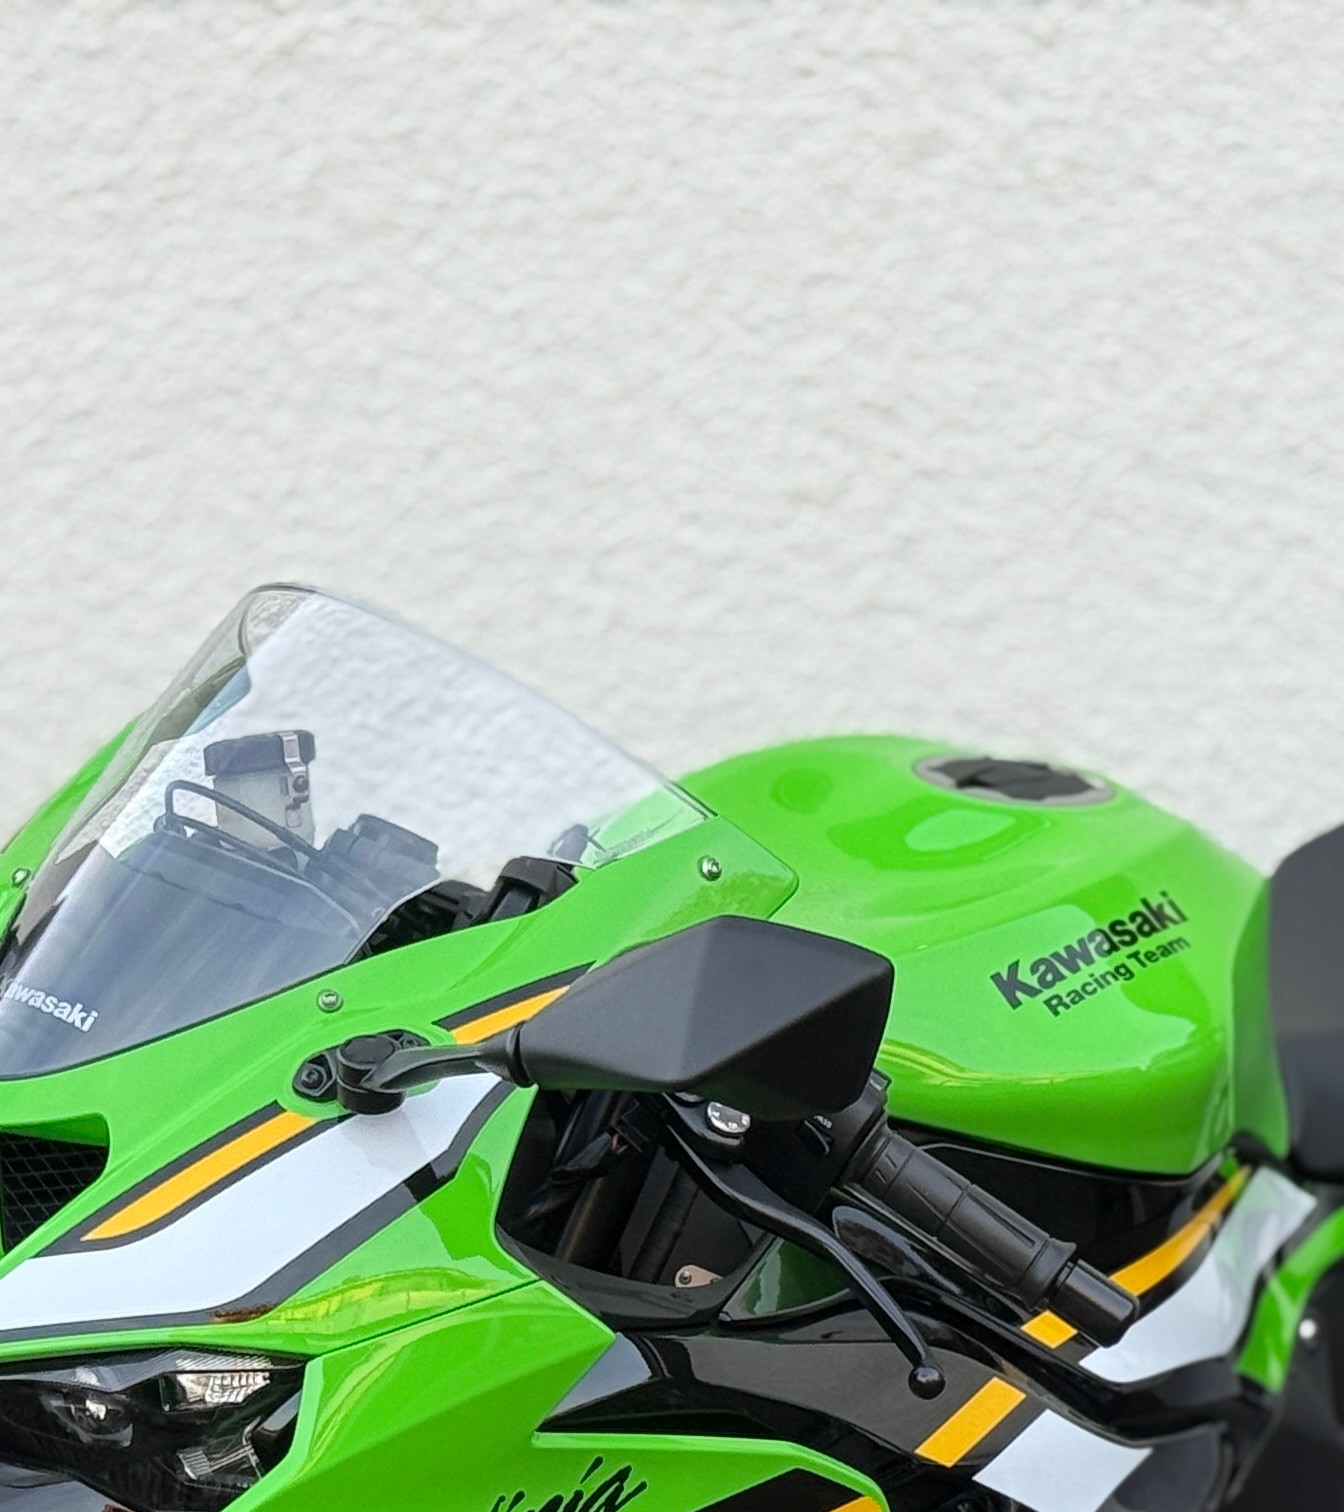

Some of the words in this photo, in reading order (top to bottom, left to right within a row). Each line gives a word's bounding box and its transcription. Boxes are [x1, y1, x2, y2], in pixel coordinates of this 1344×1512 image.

[989, 889, 1189, 1011] Kawasaki
[1042, 962, 1136, 1018] Racing
[1125, 936, 1191, 969] Team
